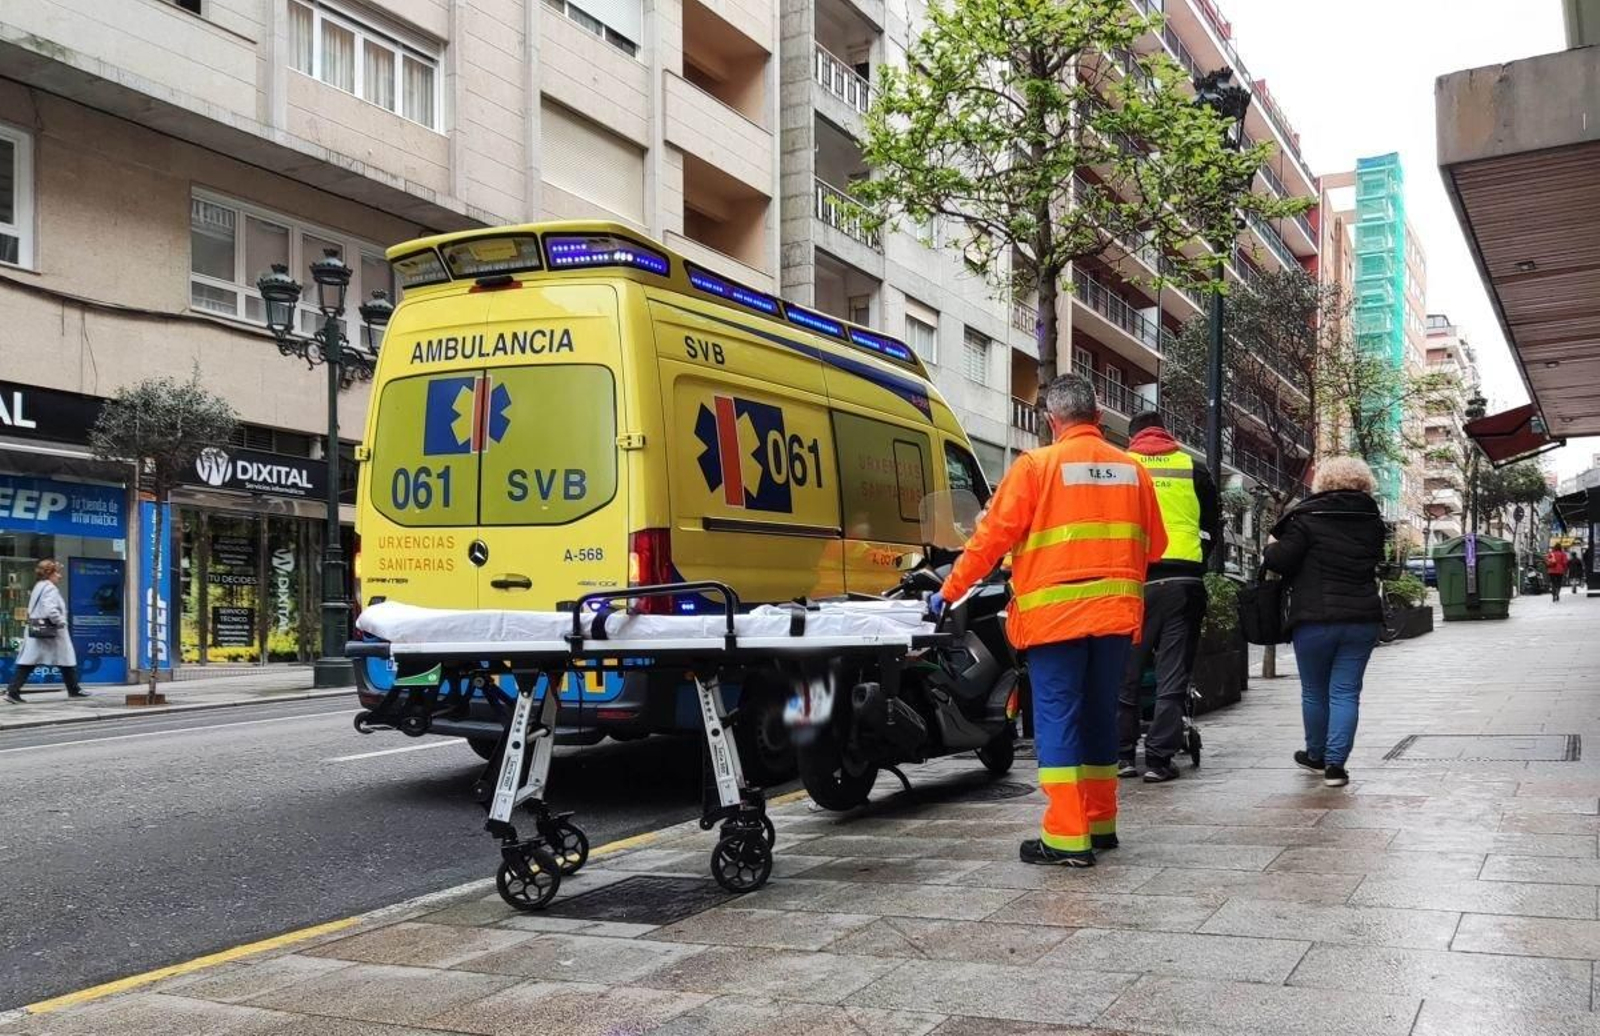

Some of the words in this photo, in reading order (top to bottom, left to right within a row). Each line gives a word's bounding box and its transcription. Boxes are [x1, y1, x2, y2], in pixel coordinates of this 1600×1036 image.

[410, 328, 575, 364] AMBULANCIA
[684, 335, 726, 365] SVB
[767, 429, 823, 488] 061
[236, 460, 313, 489] DIXITAL
[391, 465, 451, 510] 061
[507, 468, 587, 502] SVB
[1088, 468, 1117, 479] T.E.S.
[108, 499, 118, 513] de
[378, 536, 455, 549] URXENCIAS
[564, 548, 604, 561] A-568
[209, 574, 220, 582] TU
[379, 558, 455, 572] SANITARIAS
[277, 577, 289, 634] DIXITAL
